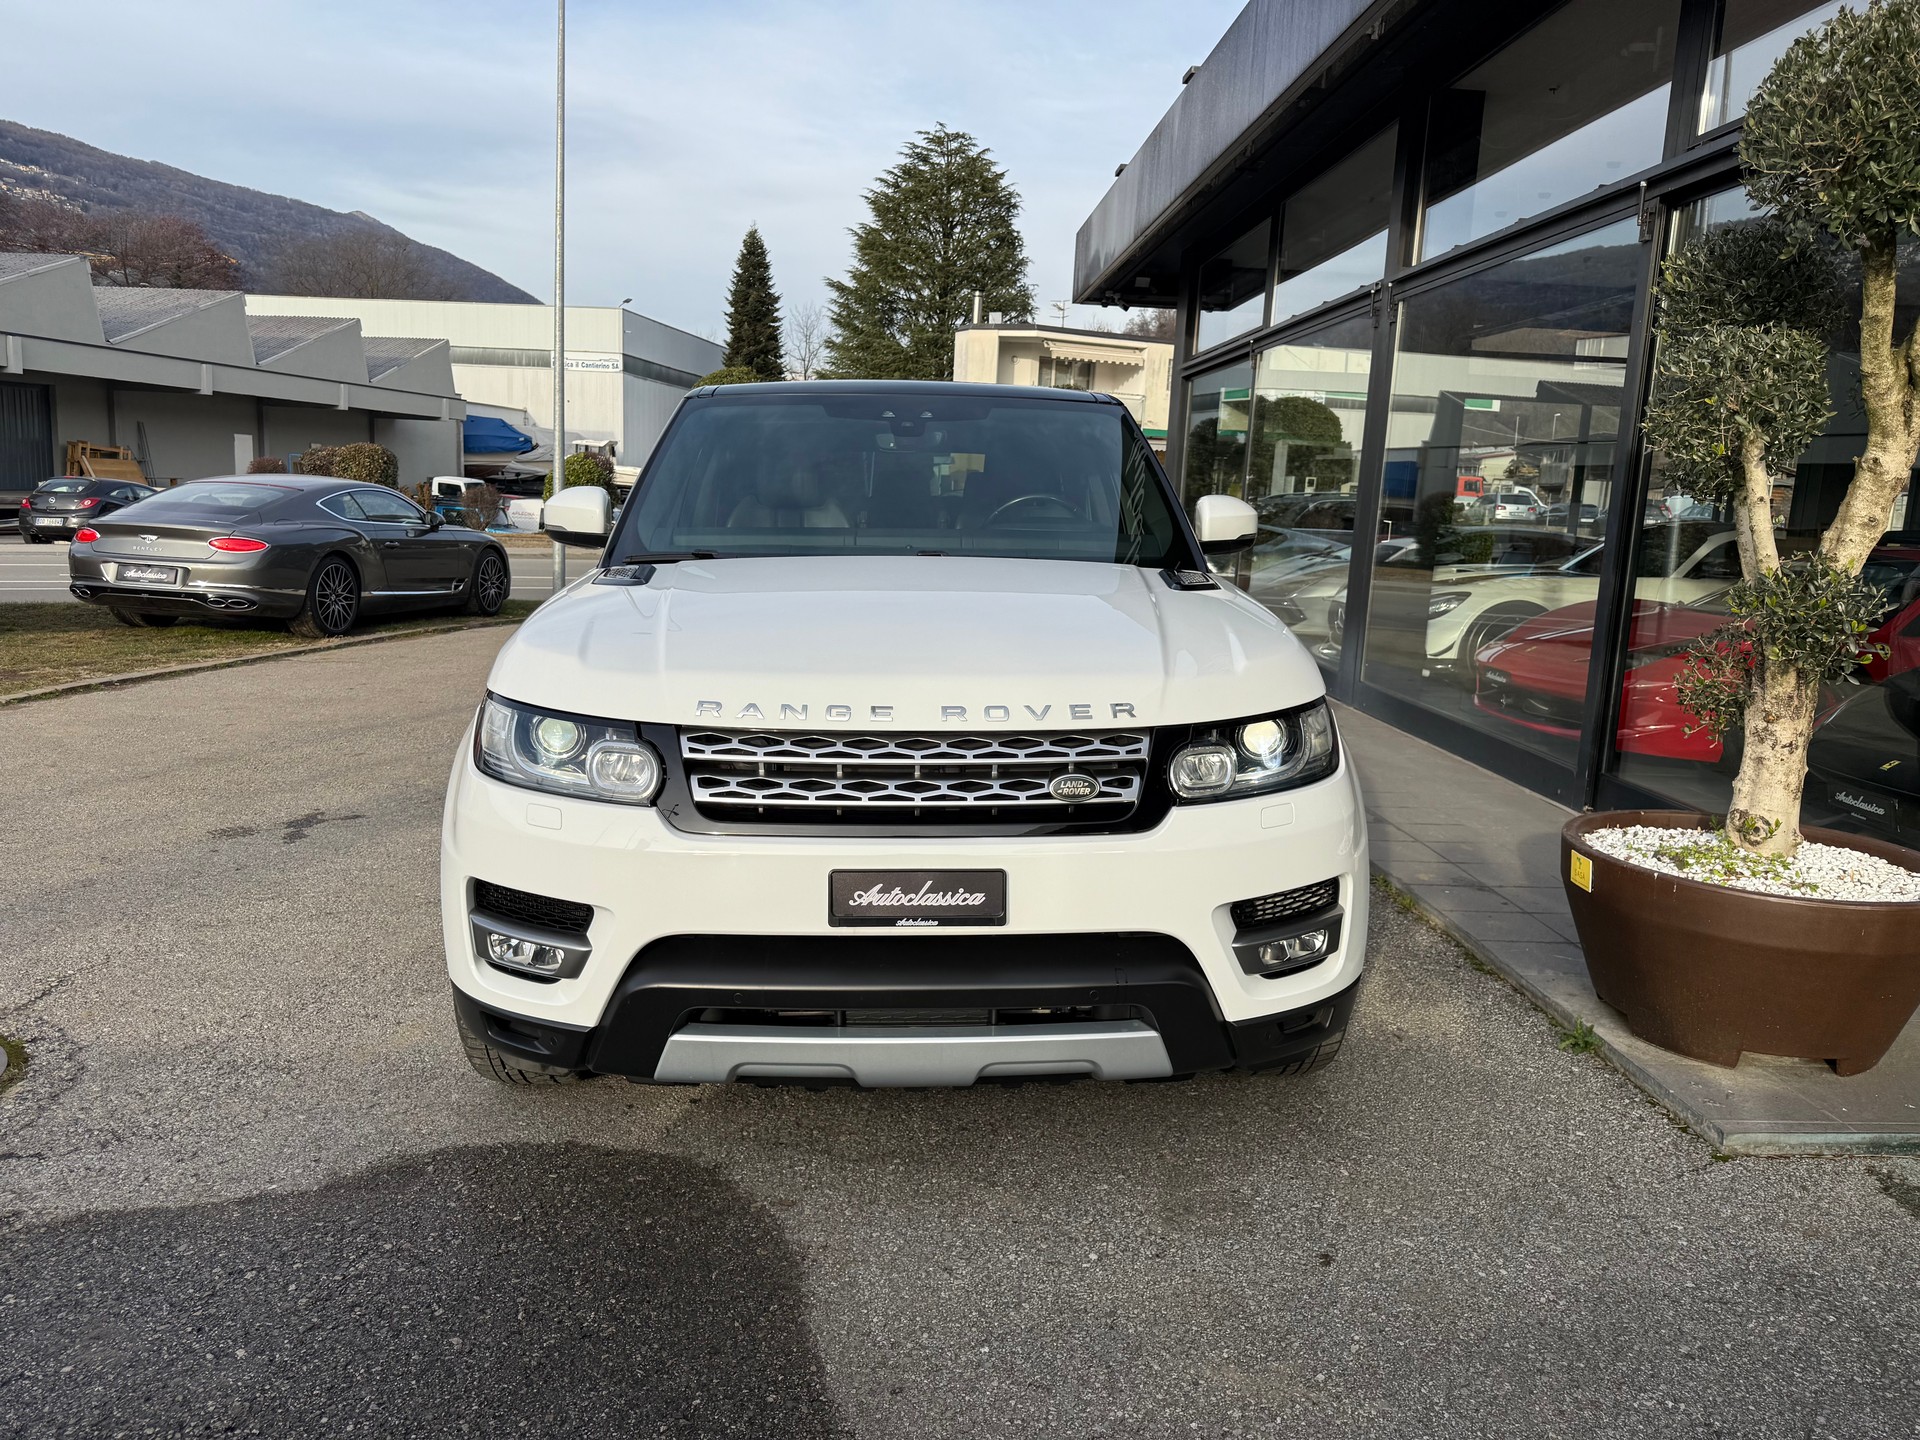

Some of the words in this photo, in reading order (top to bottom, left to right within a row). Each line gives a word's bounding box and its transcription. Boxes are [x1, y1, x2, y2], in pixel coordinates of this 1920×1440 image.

[581, 361, 610, 369] Cantierino
[695, 700, 894, 722] RANGE
[940, 702, 1137, 722] ROVER
[1834, 791, 1886, 816] Autoclassica
[848, 880, 986, 907] Autoclassica
